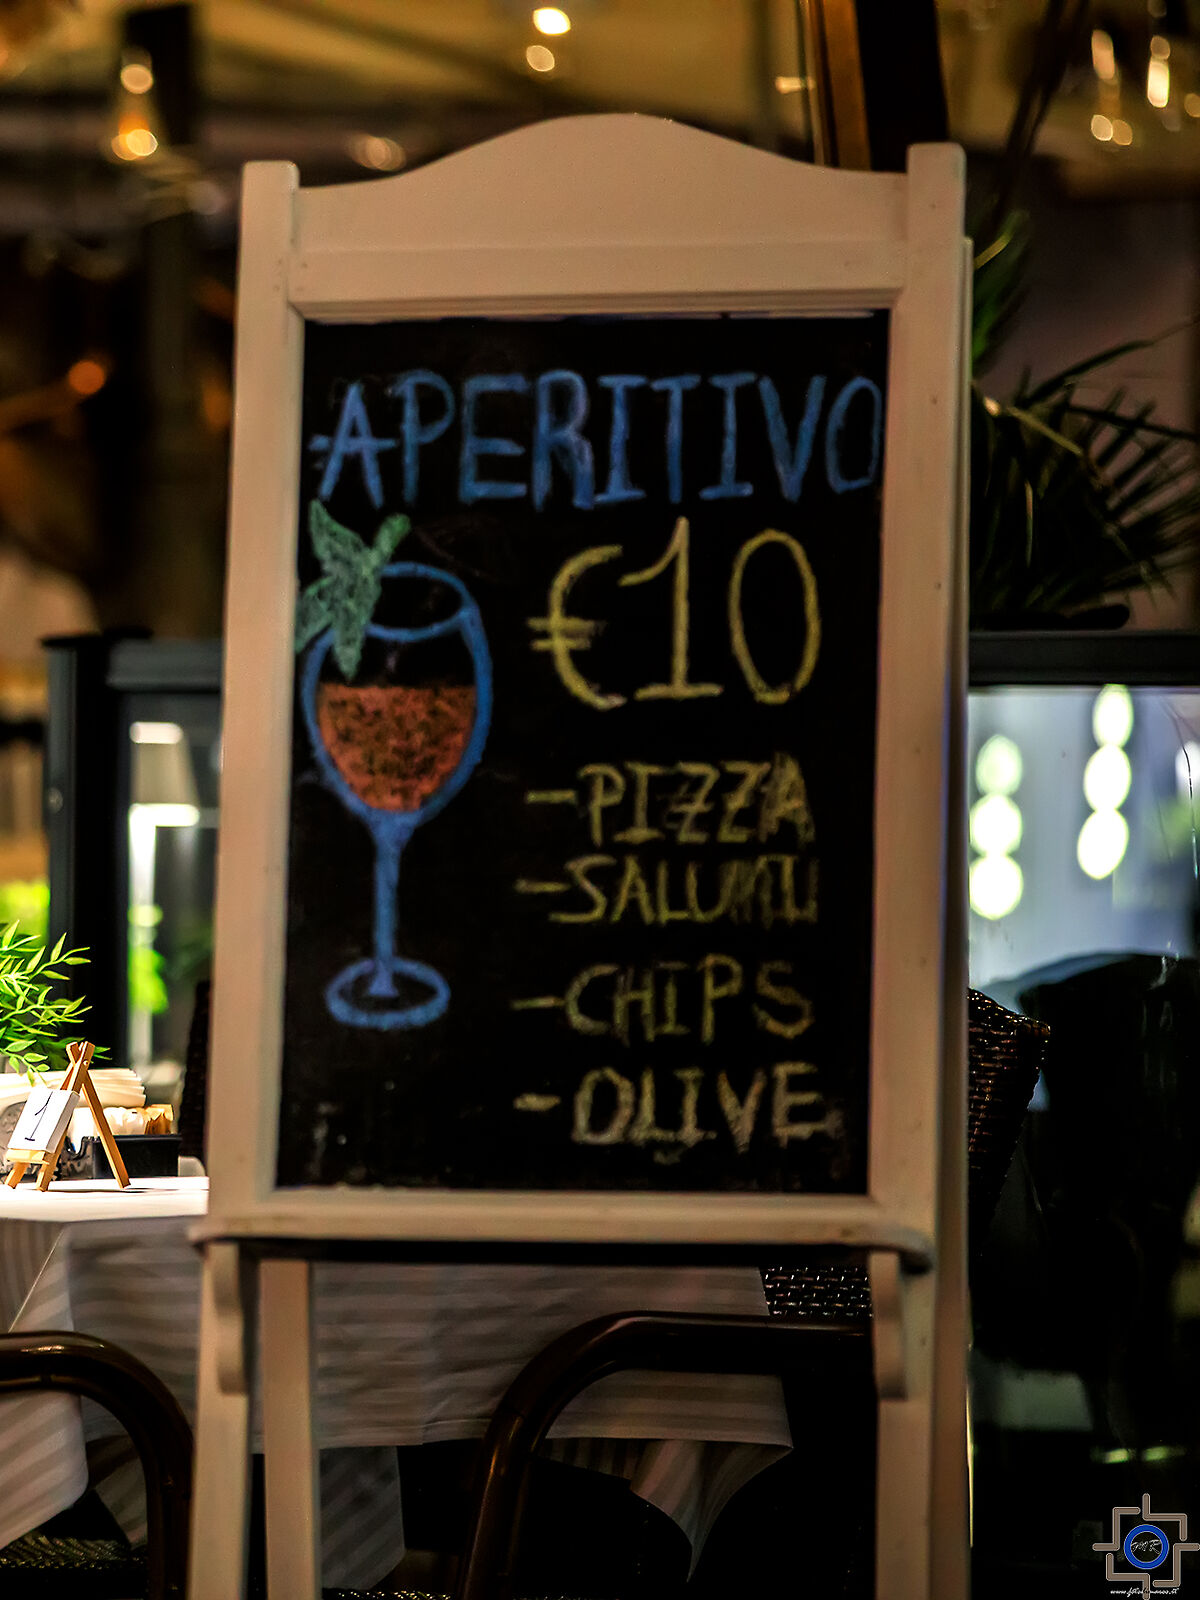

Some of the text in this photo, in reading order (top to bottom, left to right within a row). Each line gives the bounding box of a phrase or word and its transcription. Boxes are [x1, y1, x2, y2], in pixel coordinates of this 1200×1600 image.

[308, 370, 883, 510] APERITIVO
[528, 516, 821, 710] €10
[24, 1091, 54, 1142] 1
